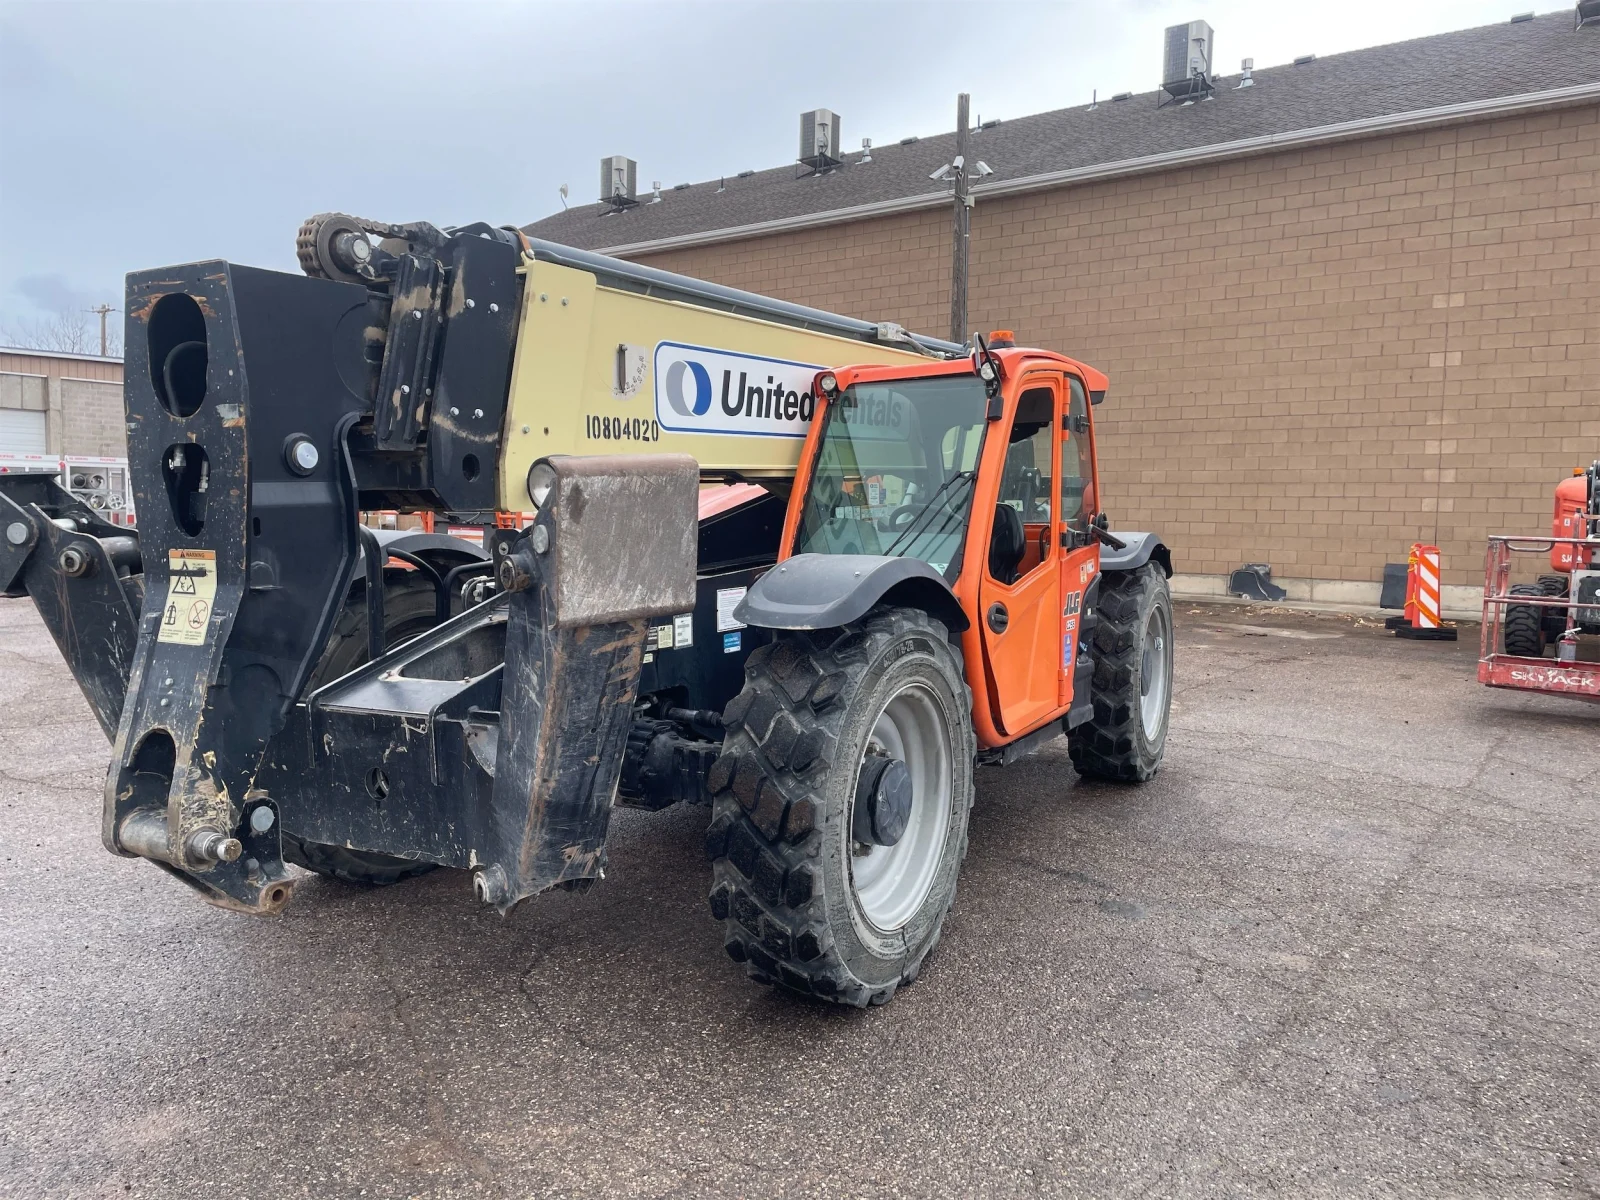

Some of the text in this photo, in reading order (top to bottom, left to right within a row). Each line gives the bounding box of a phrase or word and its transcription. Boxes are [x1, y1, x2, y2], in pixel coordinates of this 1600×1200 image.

[721, 369, 902, 428] United entals
[586, 414, 659, 442] 10804020
[1063, 591, 1080, 617] JLG
